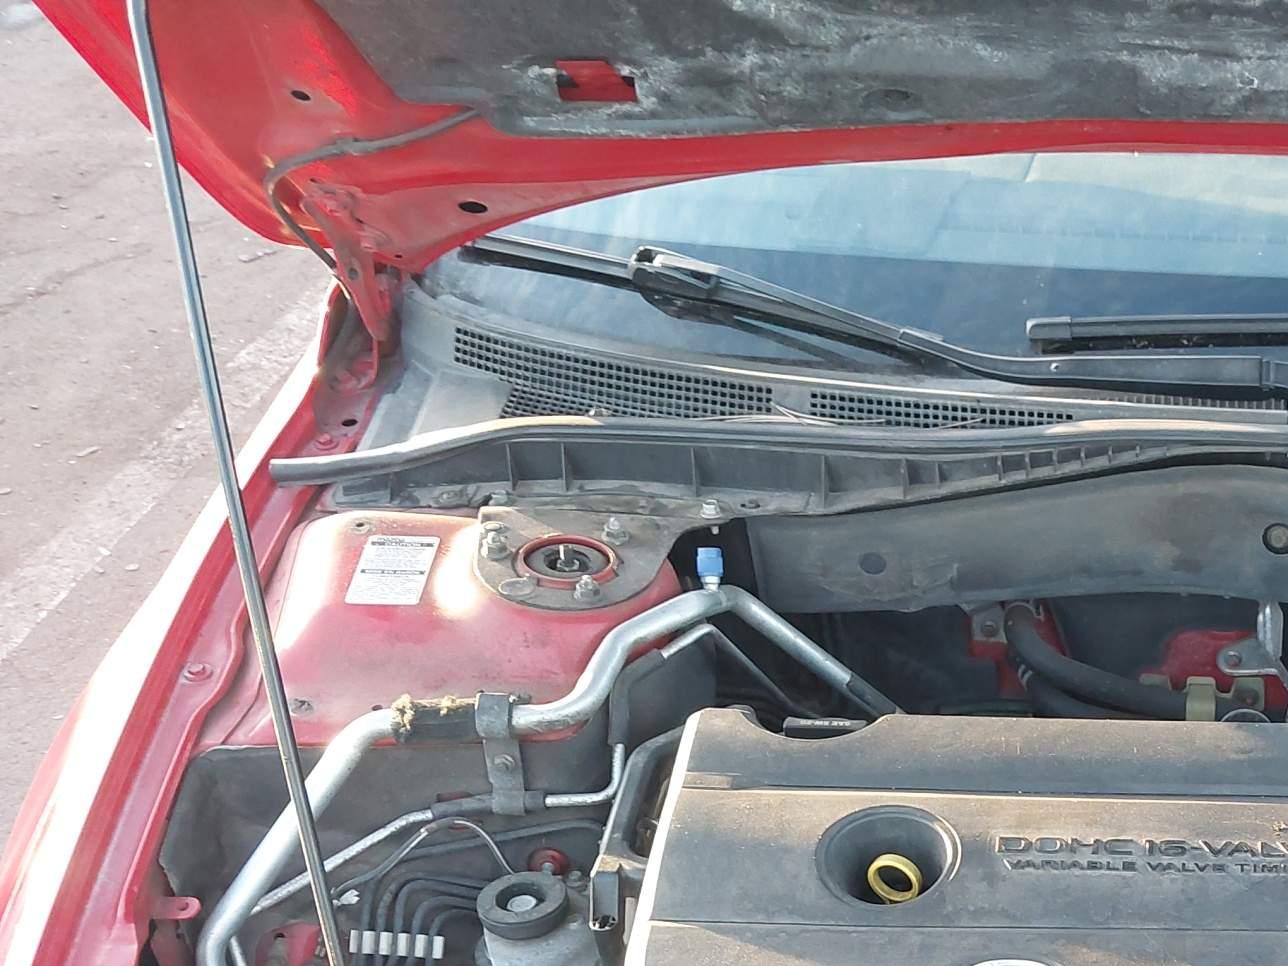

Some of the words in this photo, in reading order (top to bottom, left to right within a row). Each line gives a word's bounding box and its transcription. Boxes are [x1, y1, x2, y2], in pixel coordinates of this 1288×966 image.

[996, 835, 1135, 856] DOHC
[1003, 858, 1137, 873] VARIABLE
[1145, 861, 1227, 874] VALVE
